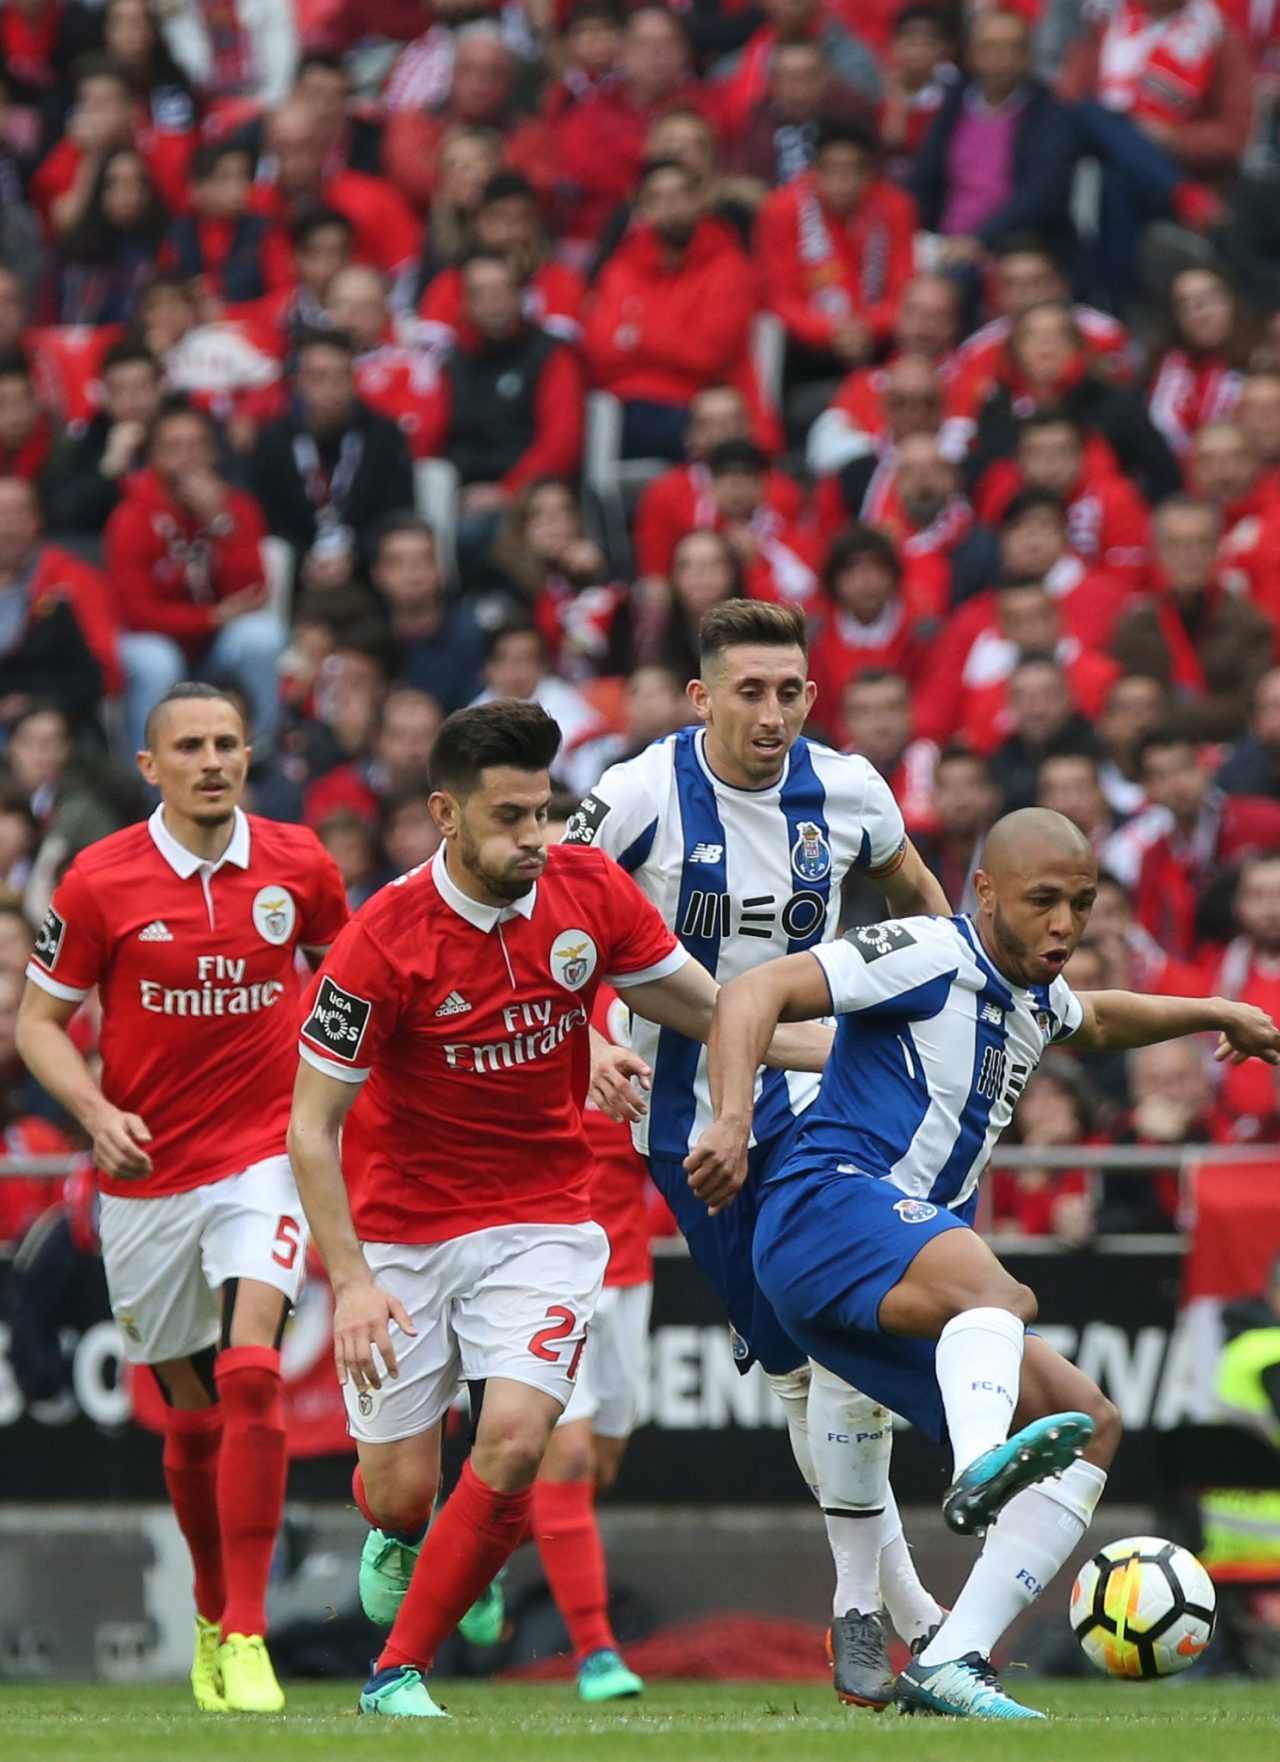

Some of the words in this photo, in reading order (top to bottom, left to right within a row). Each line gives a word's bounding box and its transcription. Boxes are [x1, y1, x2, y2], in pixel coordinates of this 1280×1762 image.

[682, 890, 827, 941] MEO
[197, 954, 246, 985] Fly
[328, 990, 352, 1014] LIGA
[435, 1002, 473, 1018] adidas
[313, 1004, 360, 1042] NOS
[502, 999, 552, 1033] Fly
[271, 1215, 300, 1270] 5
[971, 1381, 993, 1392] FC
[827, 1432, 849, 1444] FC
[1016, 1568, 1037, 1590] FC
